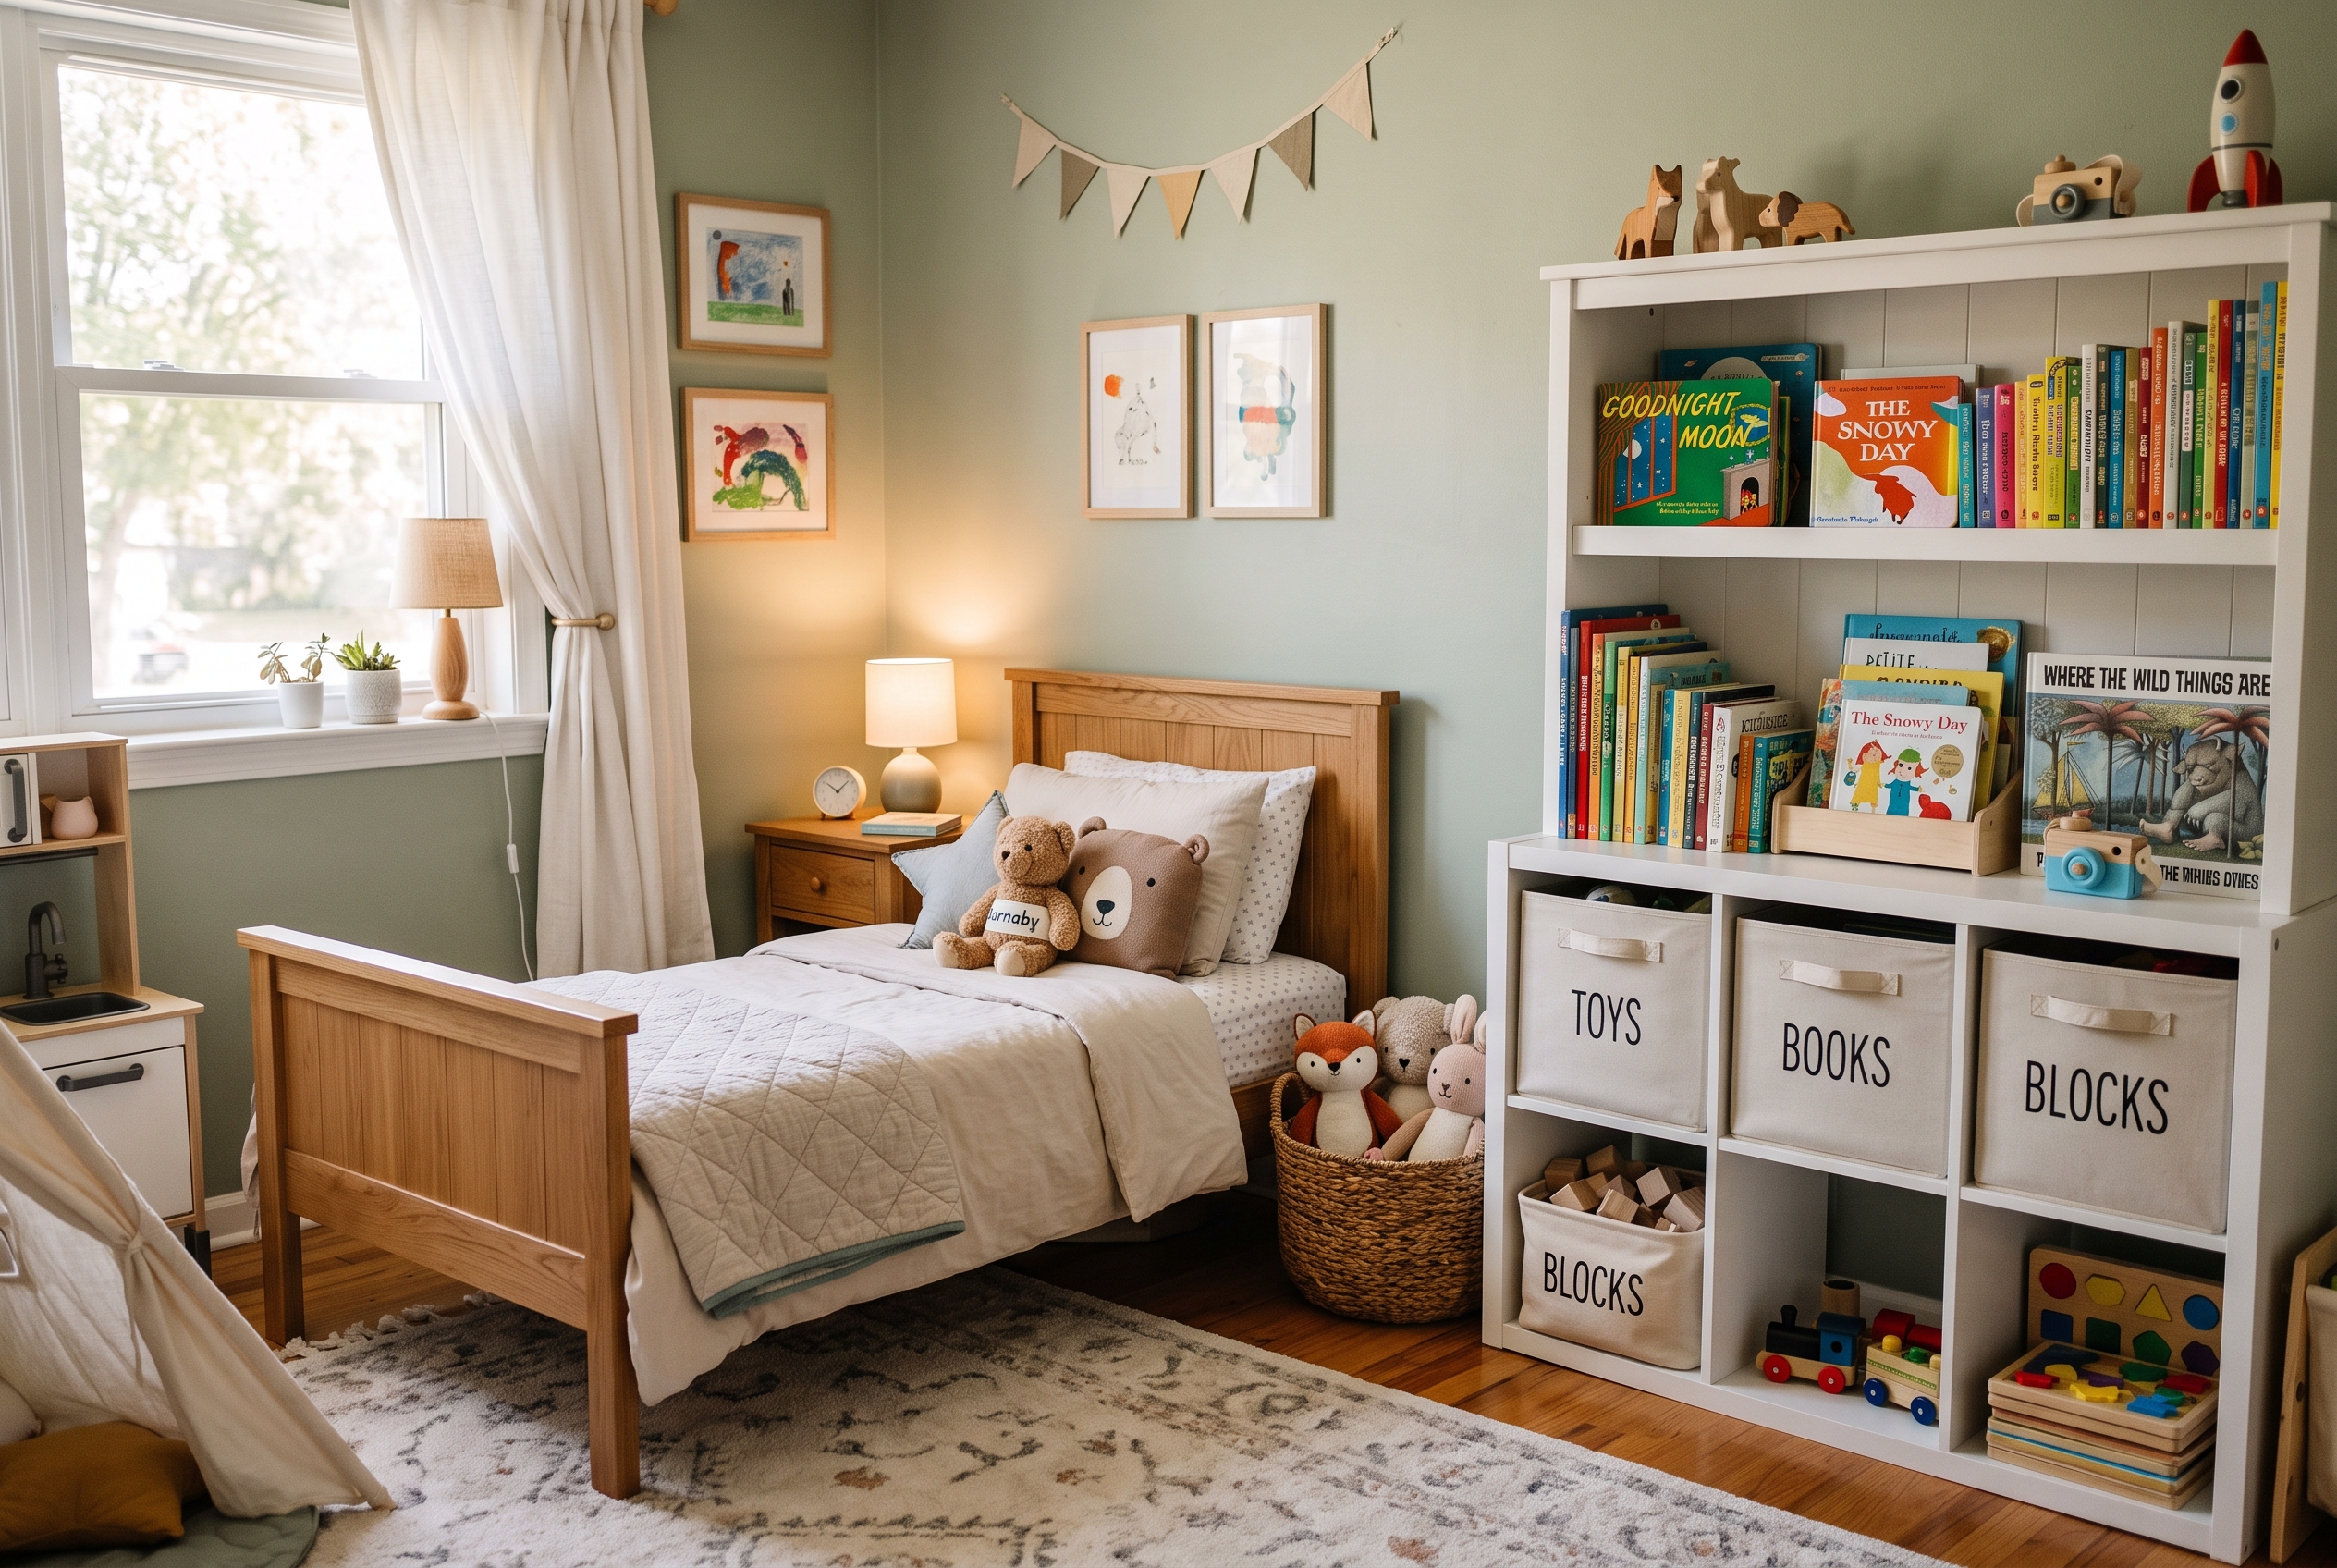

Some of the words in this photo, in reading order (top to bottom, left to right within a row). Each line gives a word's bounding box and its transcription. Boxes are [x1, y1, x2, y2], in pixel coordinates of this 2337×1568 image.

[1602, 391, 1741, 419] GOODNIGHT
[1866, 400, 1910, 416] THE
[1679, 425, 1754, 449] MOON
[1837, 420, 1938, 440] SNOWY
[1859, 443, 1915, 461] DAY
[2044, 664, 2095, 688] WHERE
[2099, 667, 2127, 690] THE
[2133, 668, 2170, 692] WILD
[2175, 670, 2233, 695] THINGS
[2237, 673, 2271, 697] ARE
[1851, 711, 1879, 726] The
[1883, 713, 1933, 732] Snowy
[1938, 716, 1968, 734] Day
[2160, 864, 2179, 882] THE
[1571, 989, 1642, 1046] TOYS
[1782, 1022, 1890, 1088] BOOKS
[2025, 1060, 2170, 1135] BLOCKS
[1544, 1251, 1644, 1317] BLOCKS
